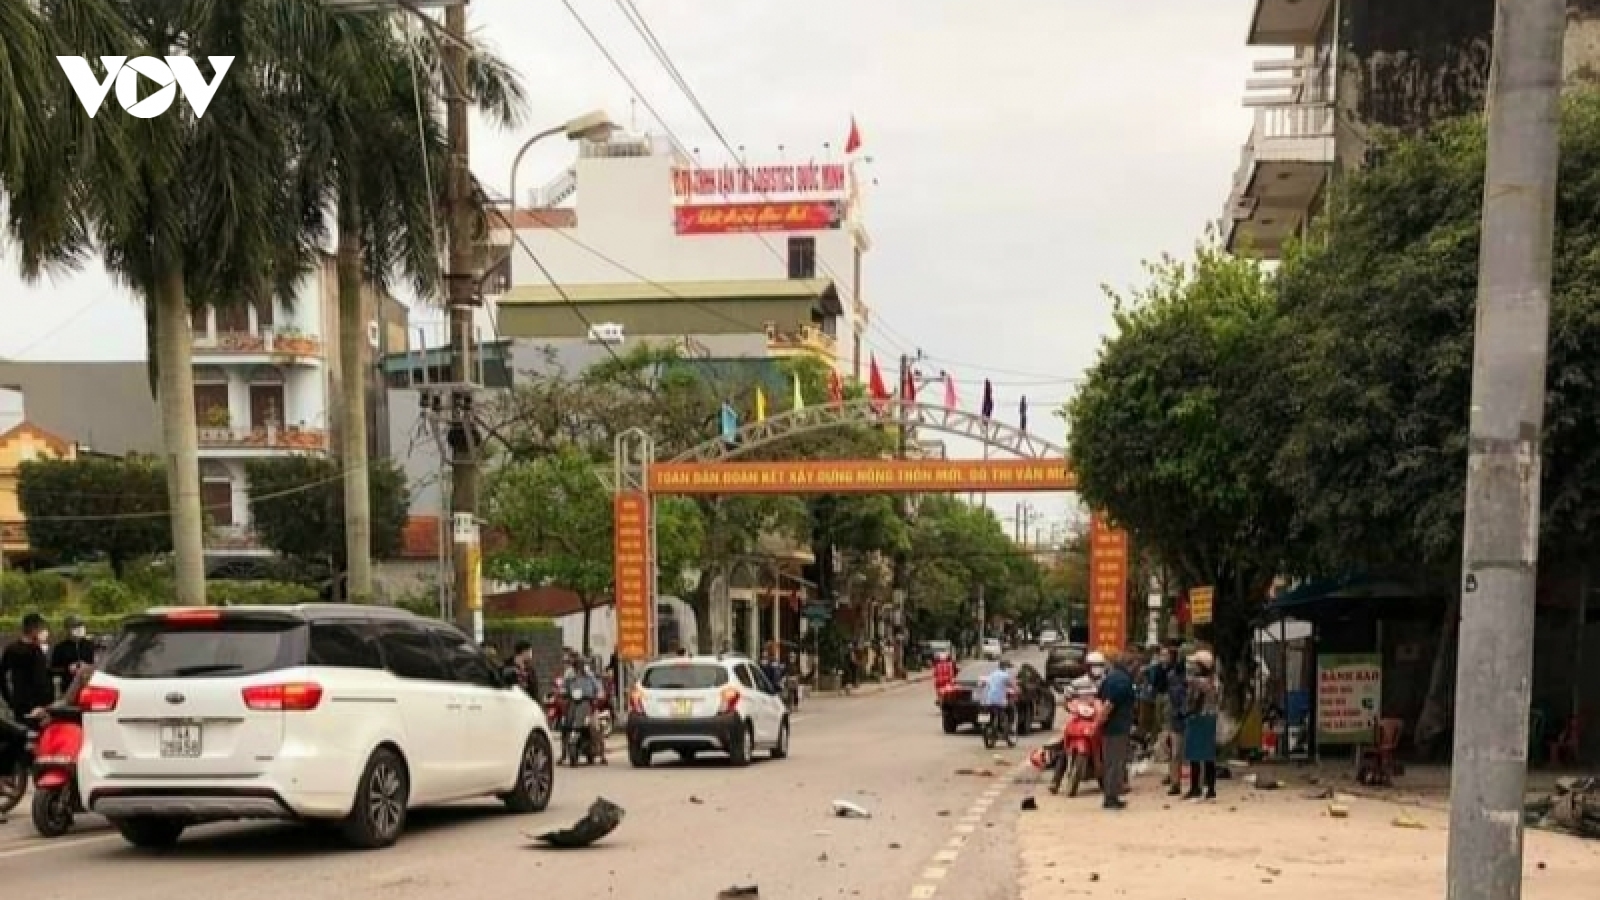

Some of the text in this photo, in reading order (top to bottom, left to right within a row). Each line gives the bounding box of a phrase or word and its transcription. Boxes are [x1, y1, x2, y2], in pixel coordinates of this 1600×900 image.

[693, 468, 720, 485] DÂN
[789, 466, 814, 484] XÂY
[857, 466, 893, 484] NÔNG
[898, 466, 932, 483] THÔN
[1015, 465, 1043, 482] VĂN
